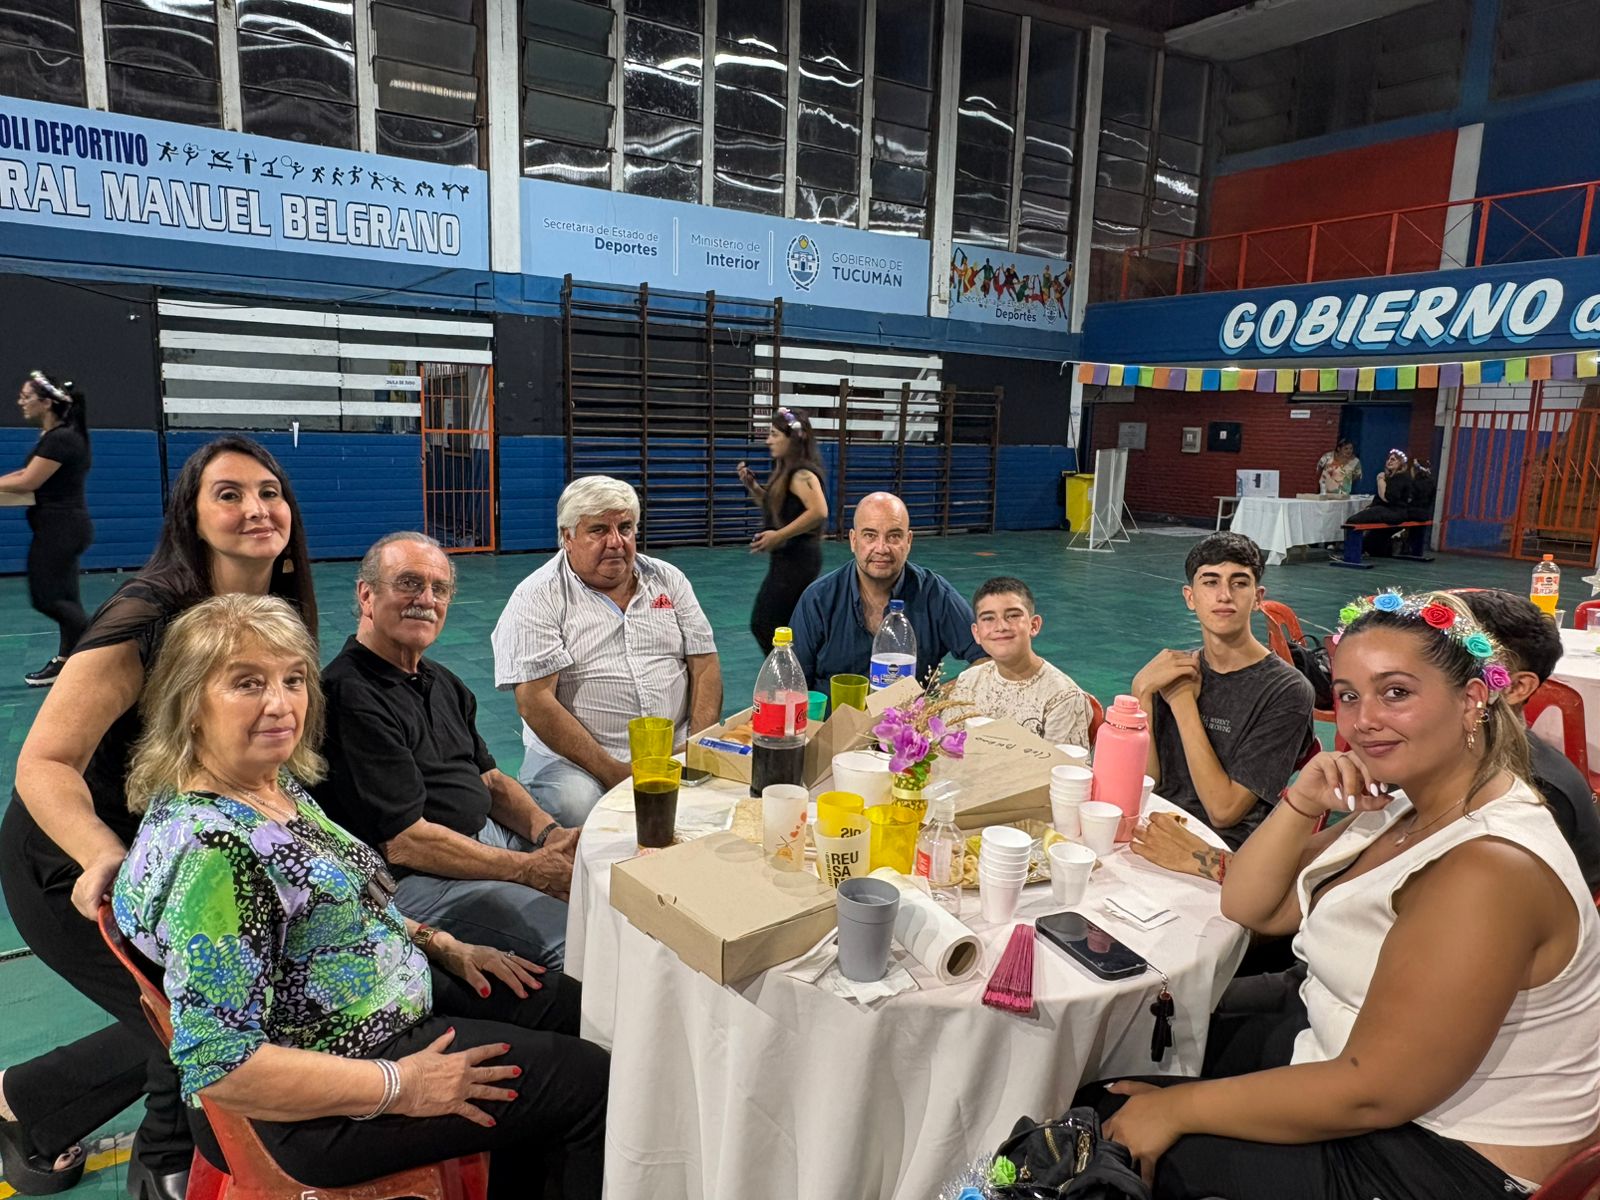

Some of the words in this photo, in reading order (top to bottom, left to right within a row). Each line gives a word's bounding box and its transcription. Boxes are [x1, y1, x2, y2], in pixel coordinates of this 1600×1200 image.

[0, 113, 31, 151] OLI
[35, 119, 149, 167] DEPORTIVO
[0, 157, 90, 217] RAL
[101, 171, 271, 236] MANUEL
[281, 193, 461, 256] BELGRANO
[597, 225, 609, 236] de
[612, 227, 644, 240] Estado
[647, 232, 658, 242] de
[594, 237, 657, 256] Deportes
[691, 234, 744, 251] Ministerio
[747, 240, 760, 253] de
[706, 252, 760, 271] Interior
[832, 252, 886, 270] GOBIERNO
[889, 260, 903, 271] DE
[832, 267, 903, 287] TUCUMÁN
[995, 308, 1037, 322] Deportes
[1219, 278, 1564, 354] GOBIERNO
[831, 851, 859, 865] REU
[832, 866, 852, 877] SA
